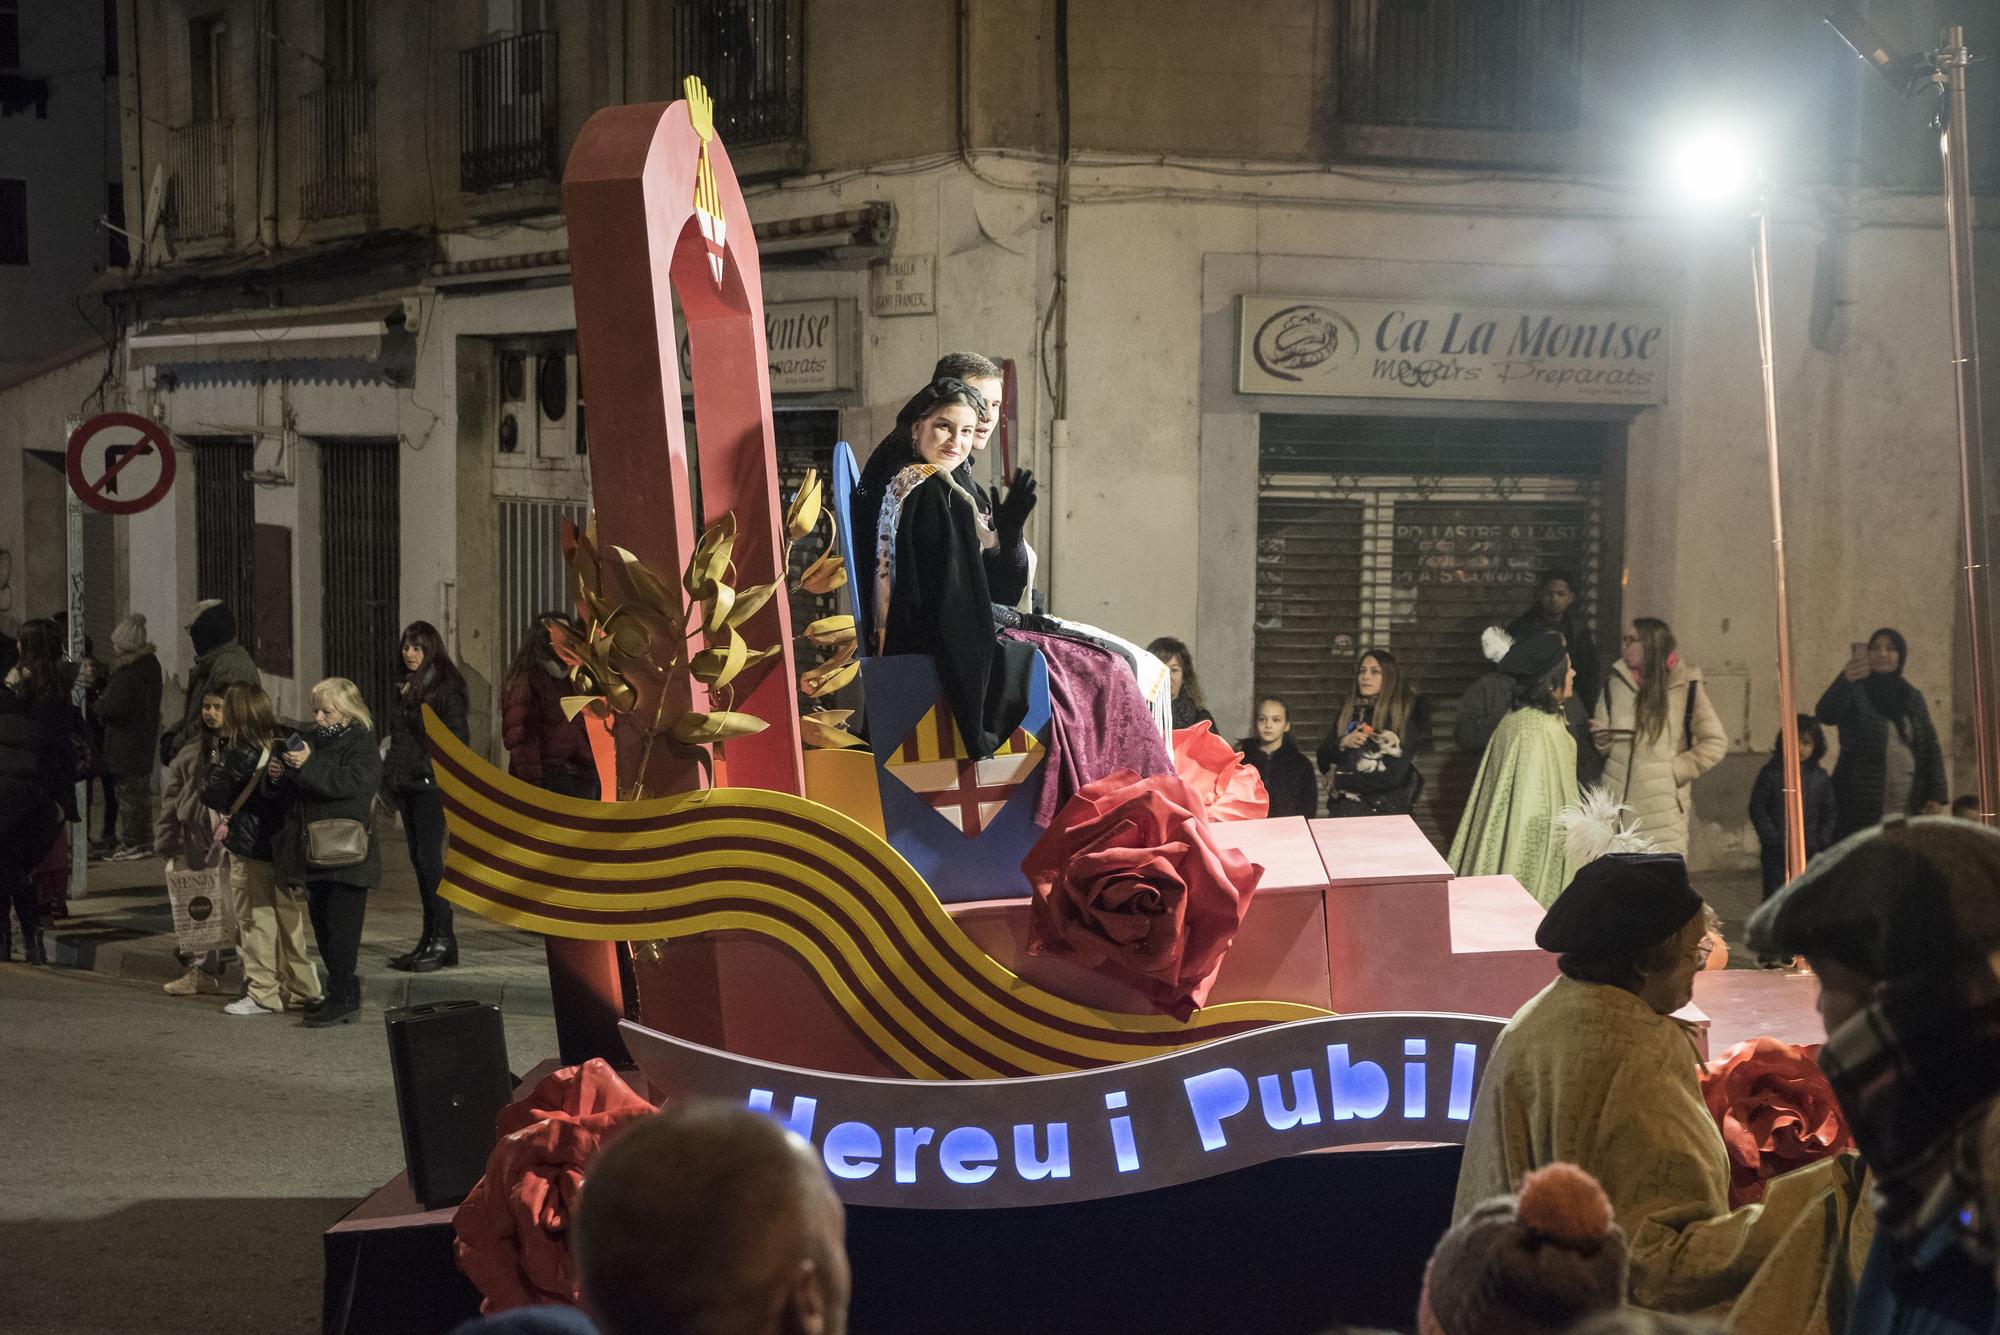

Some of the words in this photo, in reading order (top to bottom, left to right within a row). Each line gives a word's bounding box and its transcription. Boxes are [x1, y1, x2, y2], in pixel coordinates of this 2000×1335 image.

[1375, 310, 1430, 354] Ca
[1441, 312, 1498, 355] La
[1507, 314, 1662, 360] Montse
[1492, 359, 1656, 387] Preparats
[1105, 1090, 1140, 1173] i
